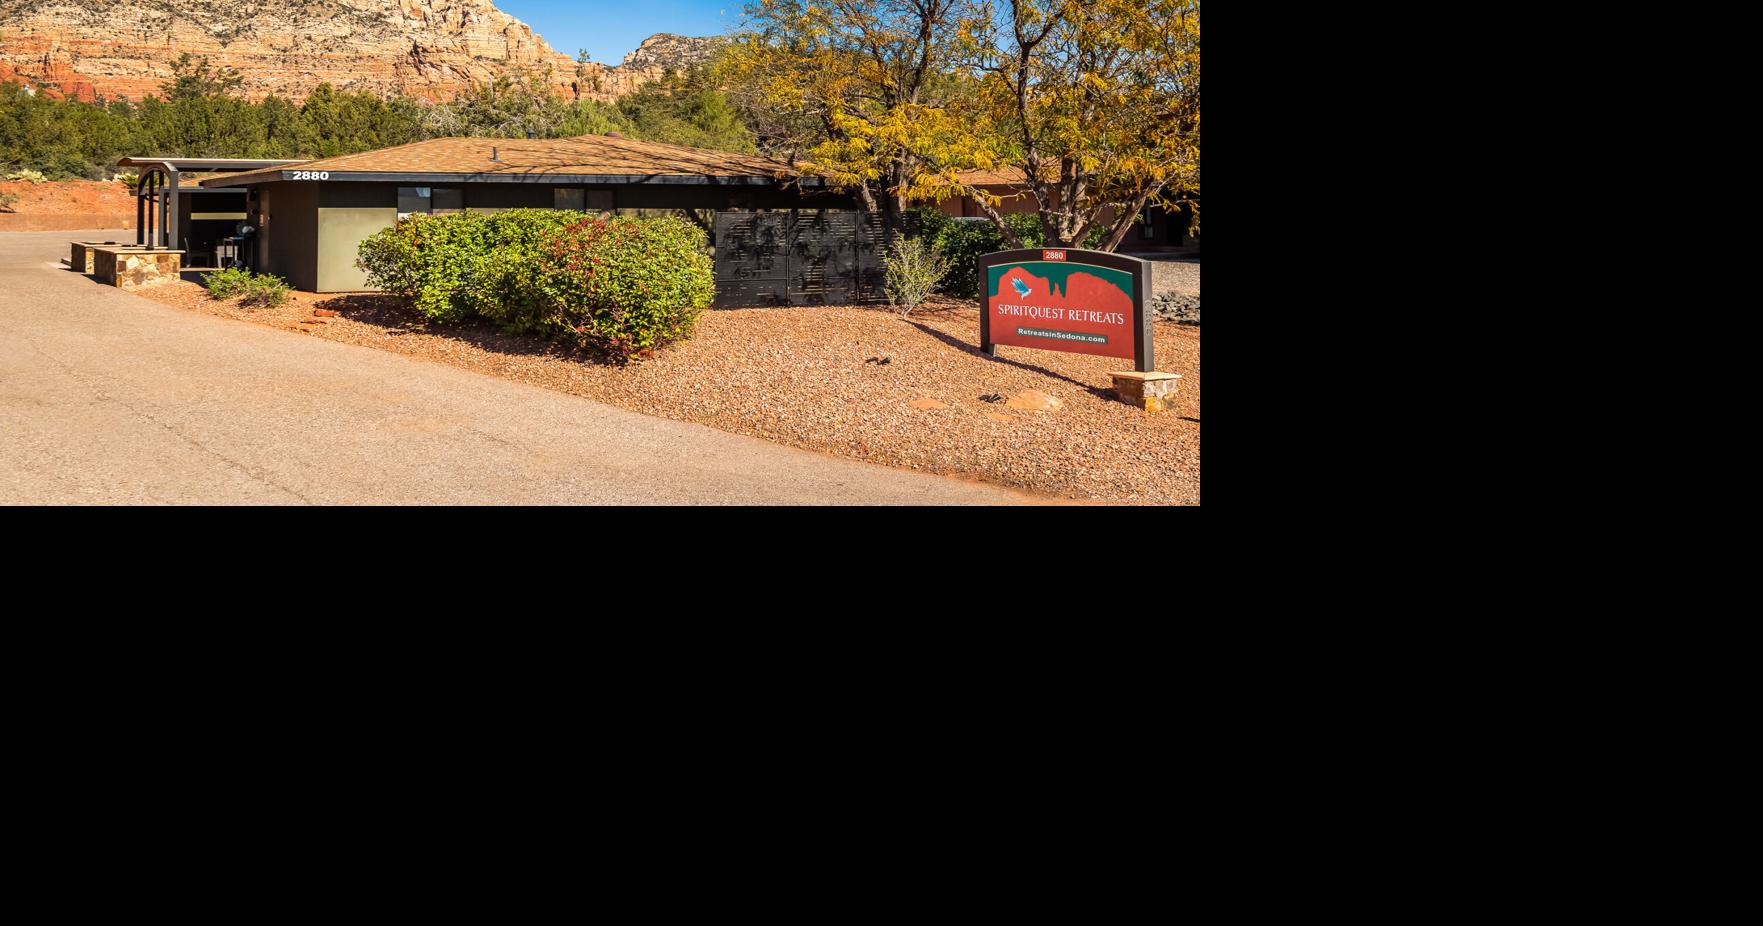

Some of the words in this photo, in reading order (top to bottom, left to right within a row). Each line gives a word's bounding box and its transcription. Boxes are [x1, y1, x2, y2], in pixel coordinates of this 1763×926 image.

[293, 171, 329, 180] 2880
[1045, 251, 1064, 260] 2880
[998, 304, 1065, 319] SPIRITQUEST
[1068, 309, 1124, 325] RETREATS
[1018, 328, 1105, 343] RetreatsInSedona.com
